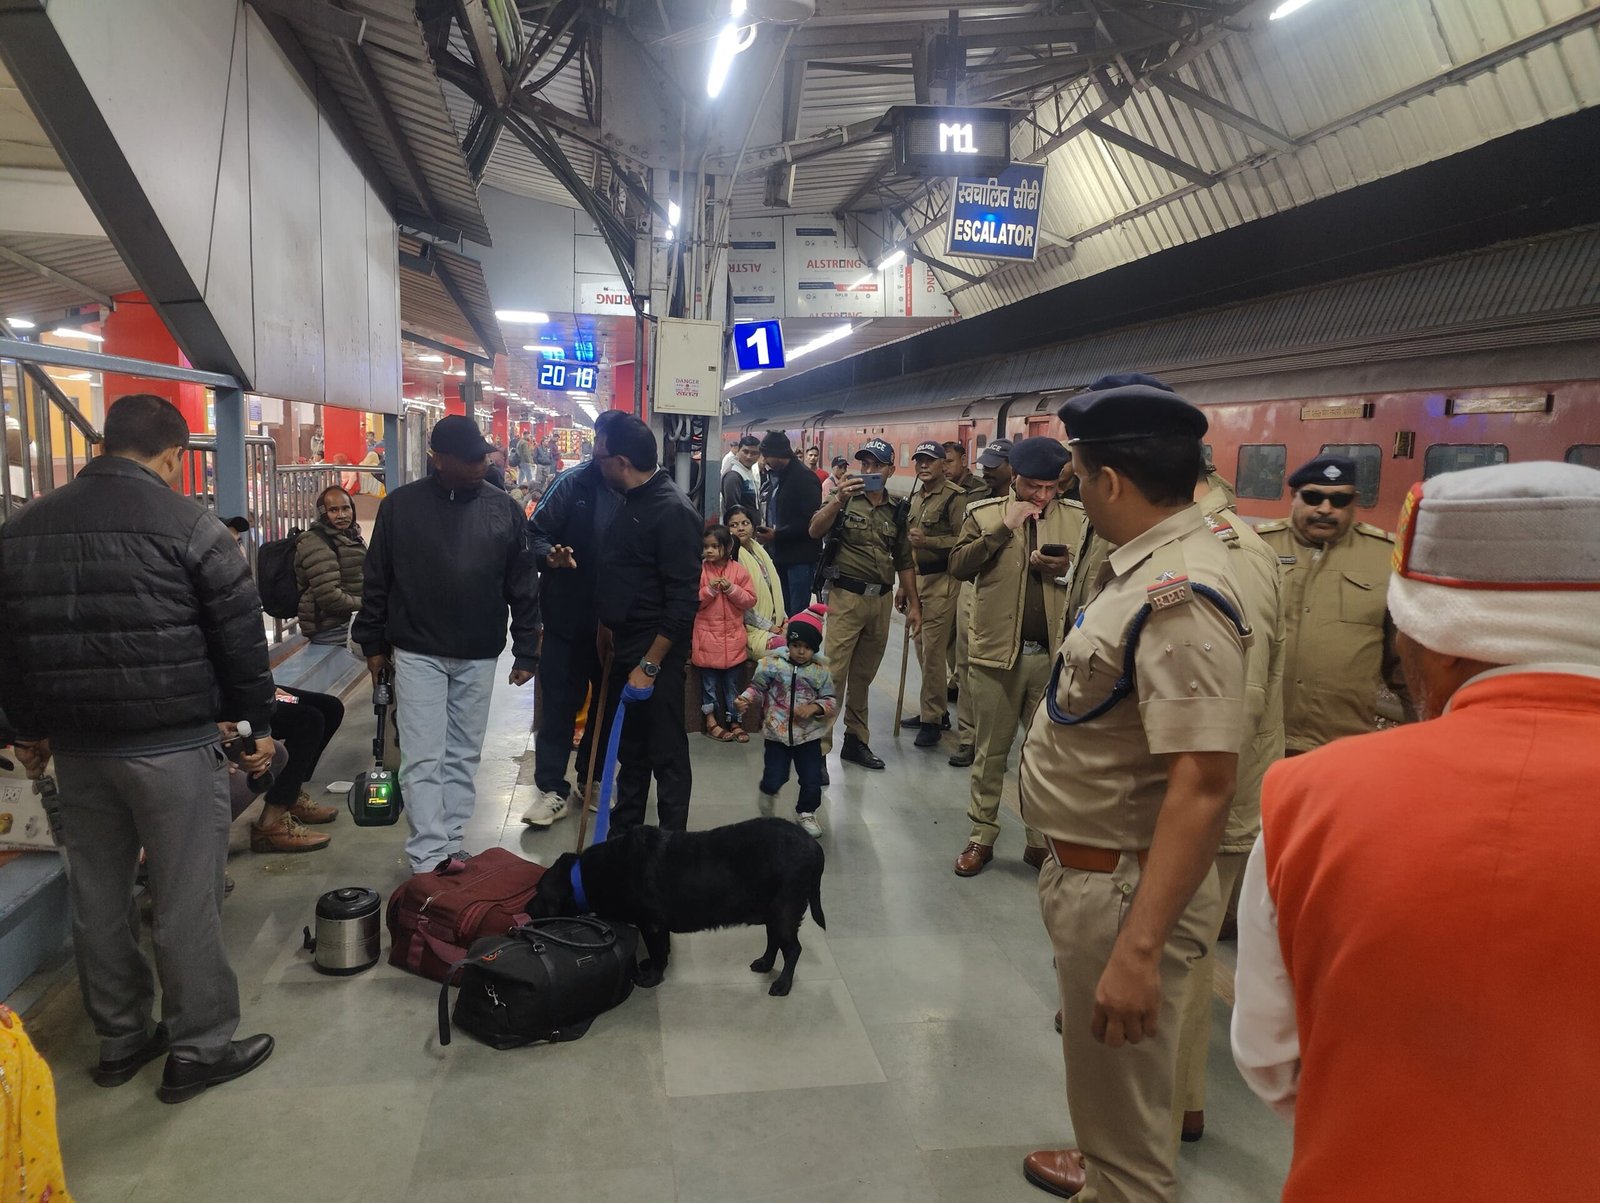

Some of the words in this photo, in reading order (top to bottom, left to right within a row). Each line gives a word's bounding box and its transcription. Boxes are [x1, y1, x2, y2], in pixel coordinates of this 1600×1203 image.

[939, 123, 978, 153] M1
[958, 177, 1011, 208] स्वचालित
[954, 219, 1034, 247] ESCALATOR
[806, 259, 862, 269] ALSTRONG
[746, 327, 770, 365] 1
